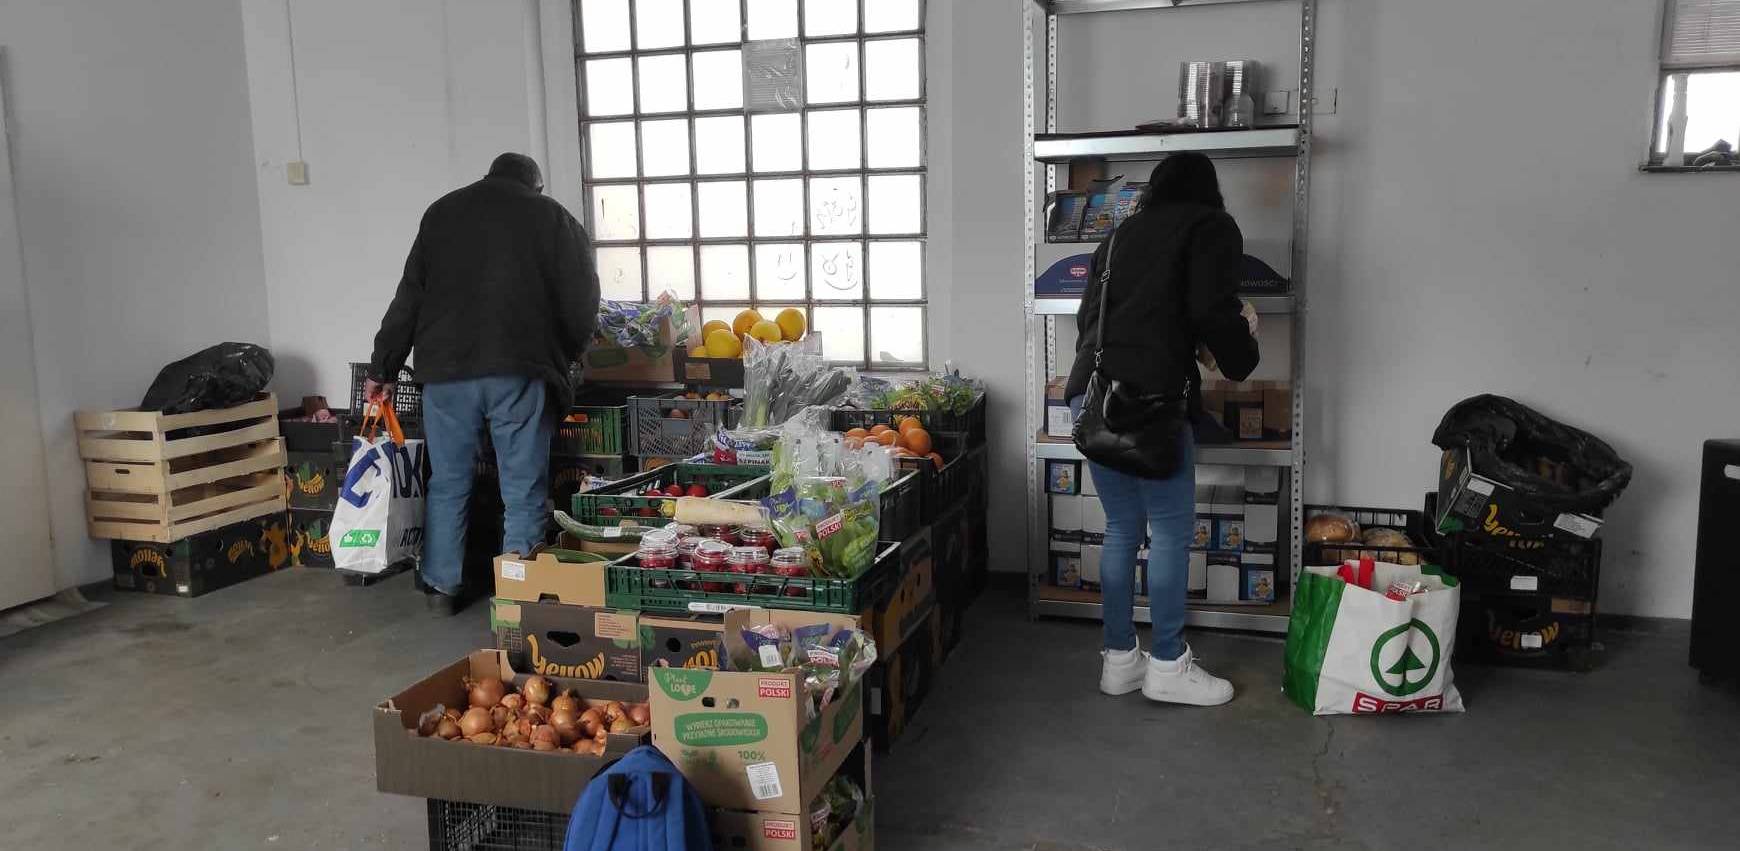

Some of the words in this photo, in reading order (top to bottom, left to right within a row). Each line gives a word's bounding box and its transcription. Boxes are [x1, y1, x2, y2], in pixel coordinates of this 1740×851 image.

[818, 522, 842, 541] POLSKI
[760, 688, 789, 698] POLSKI
[1358, 697, 1441, 712] SPAR
[766, 830, 794, 839] POLSKI
